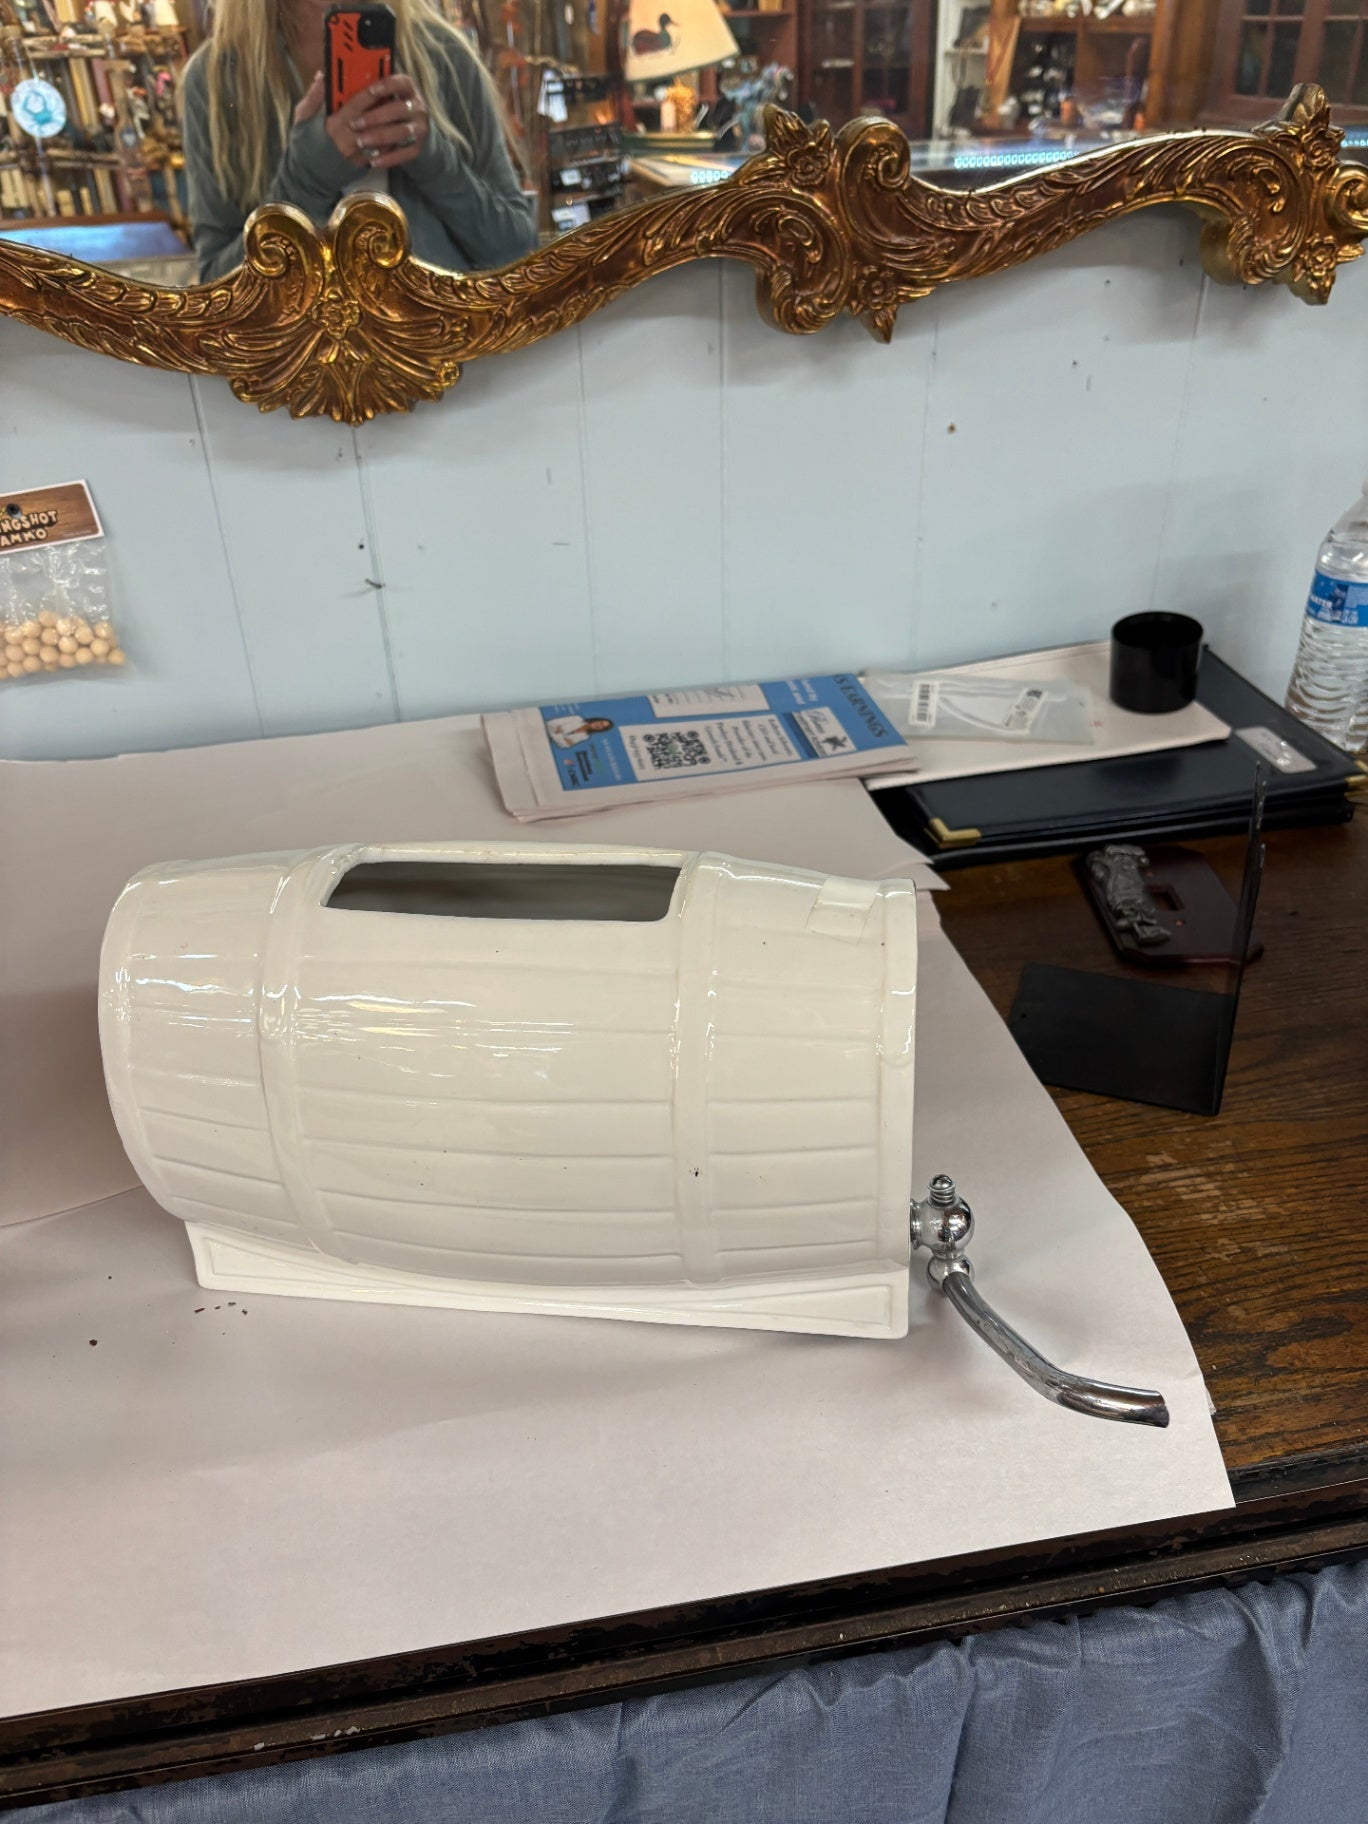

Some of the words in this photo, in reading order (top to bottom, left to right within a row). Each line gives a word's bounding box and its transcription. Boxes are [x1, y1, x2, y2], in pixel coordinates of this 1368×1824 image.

[0, 511, 57, 533] NGSHOT
[0, 528, 47, 546] AMMO
[840, 686, 889, 738] EARNINGS
